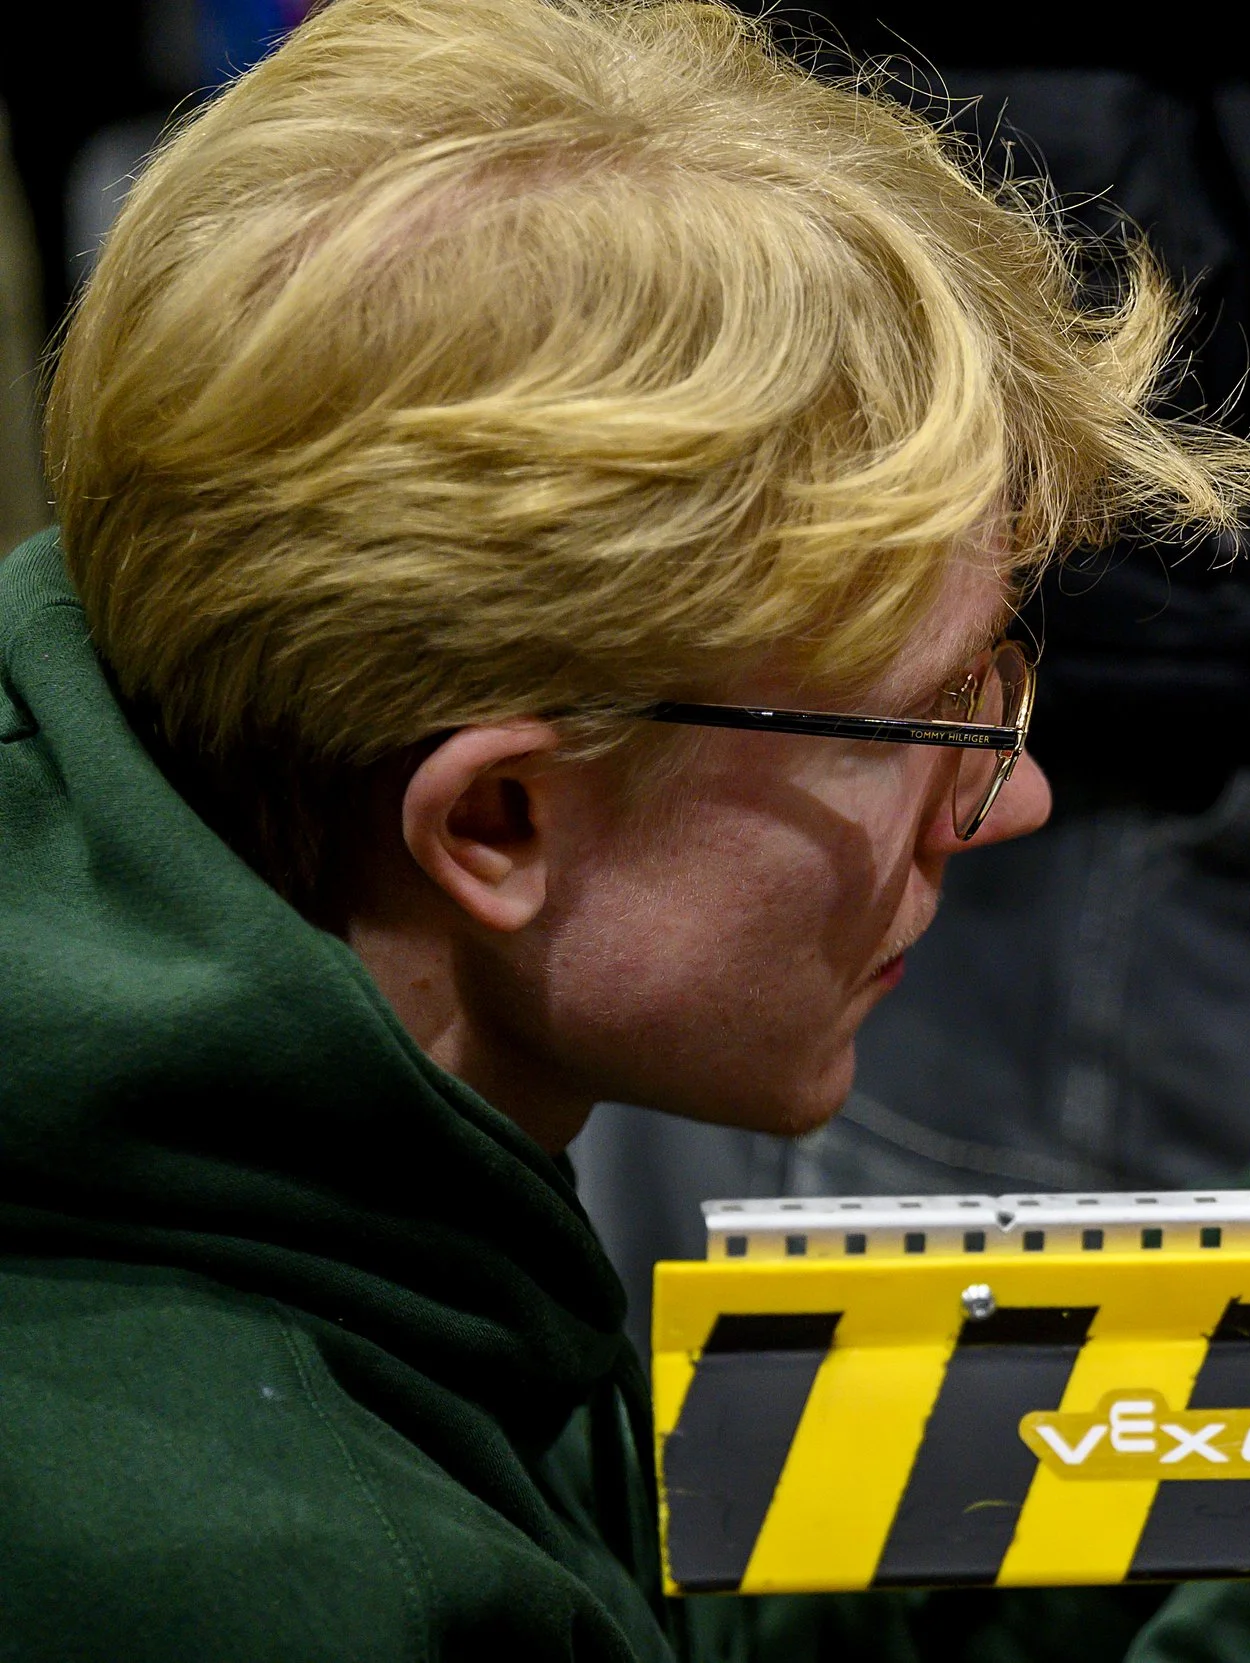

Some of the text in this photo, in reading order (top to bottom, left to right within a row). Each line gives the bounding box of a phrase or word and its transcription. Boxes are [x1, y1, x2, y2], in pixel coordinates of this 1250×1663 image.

[910, 729, 990, 744] TOMMY HILFIGER
[1036, 1400, 1229, 1465] VEX
